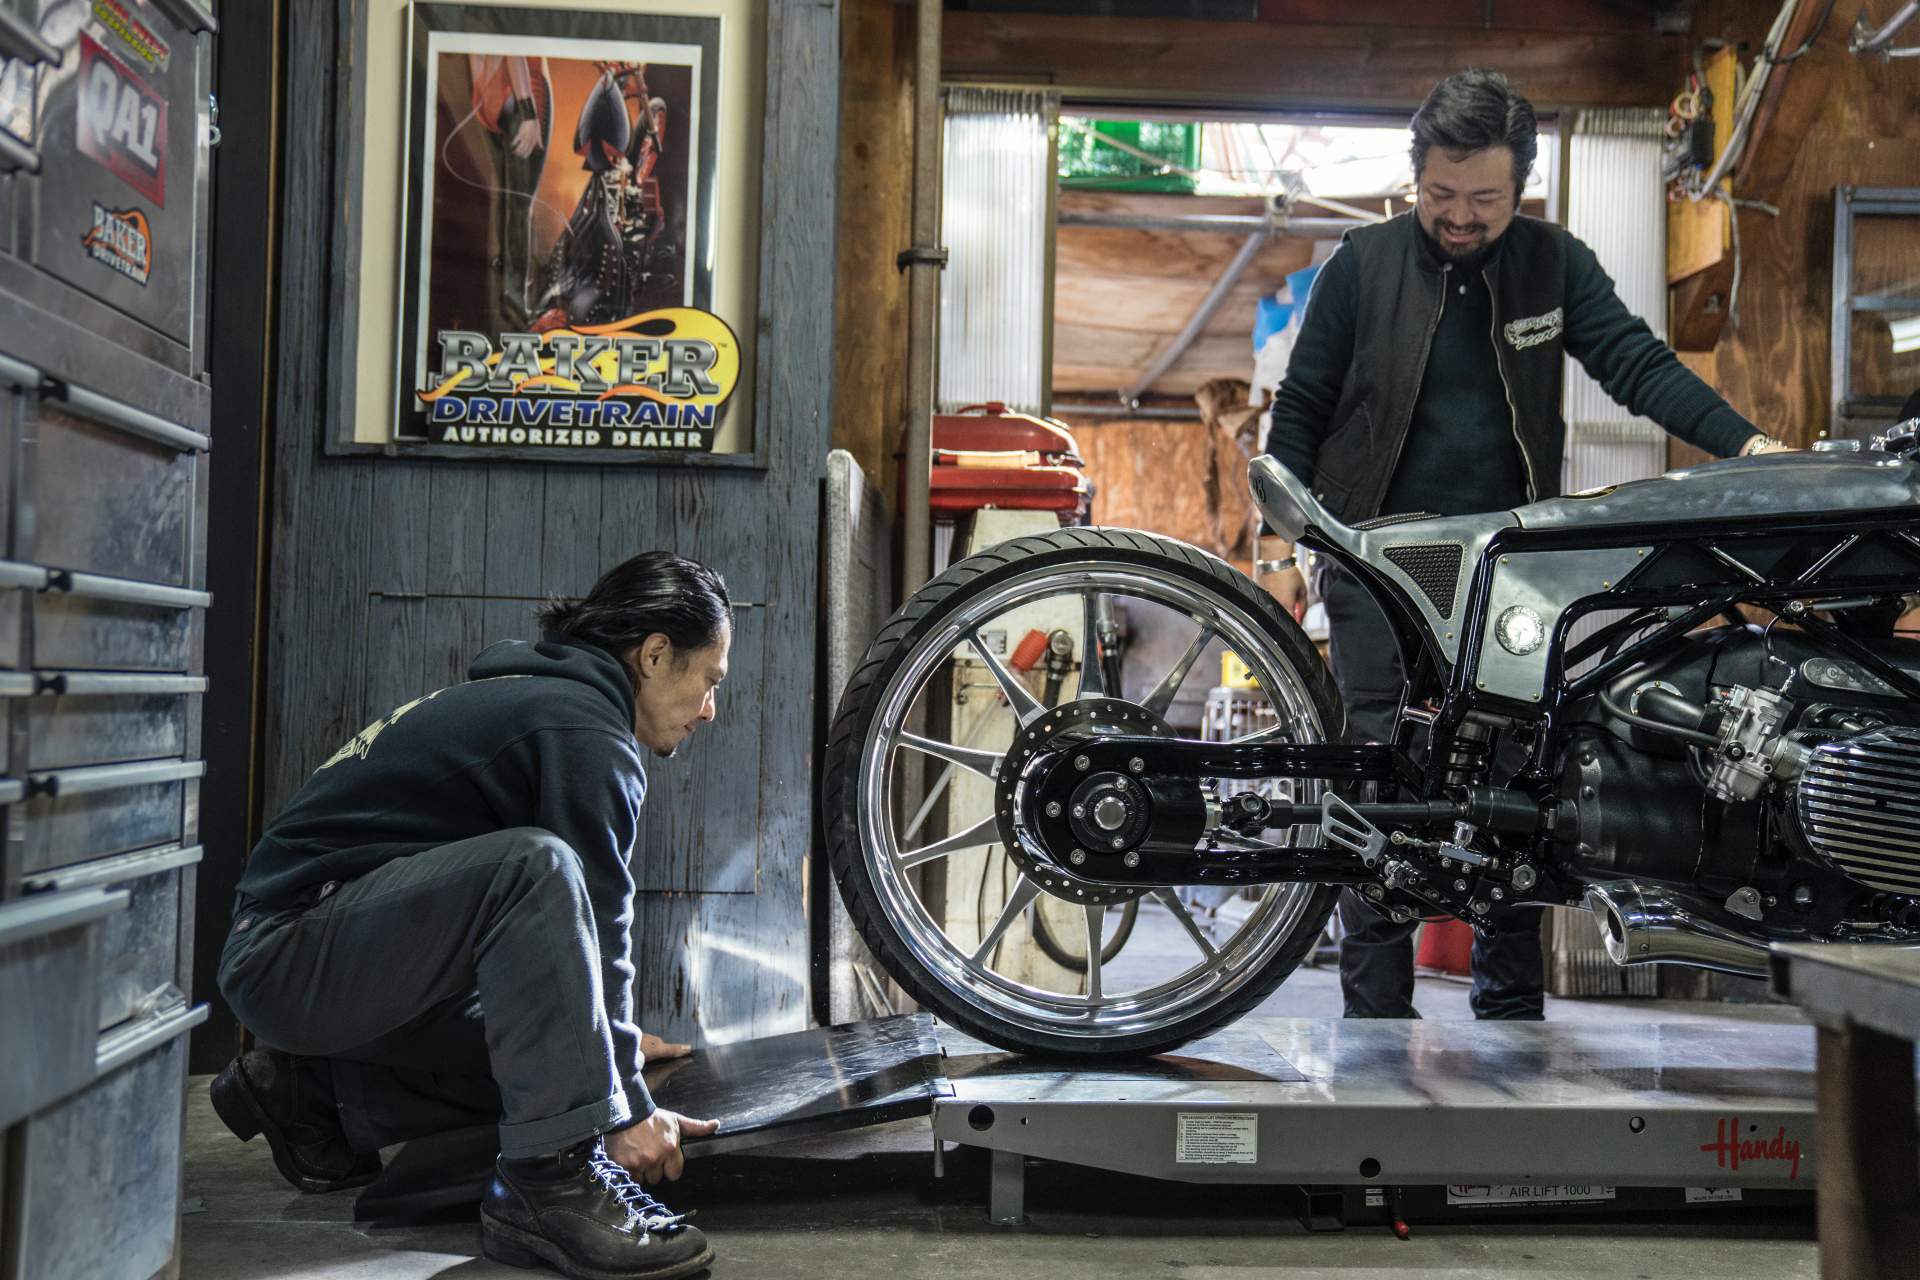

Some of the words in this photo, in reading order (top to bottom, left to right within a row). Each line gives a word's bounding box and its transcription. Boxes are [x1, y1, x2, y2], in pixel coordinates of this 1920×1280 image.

[88, 62, 158, 168] QA1
[94, 204, 147, 264] BAKER
[437, 330, 720, 397] BAKER
[432, 396, 716, 429] DRIVETRAIN
[442, 426, 601, 447] AUTHORIZED
[612, 430, 702, 447] DEALER
[1700, 1117, 1799, 1179] Handy
[1510, 1186, 1530, 1198] AIR
[1534, 1185, 1559, 1197] LIFT
[1564, 1184, 1591, 1196] 1000
